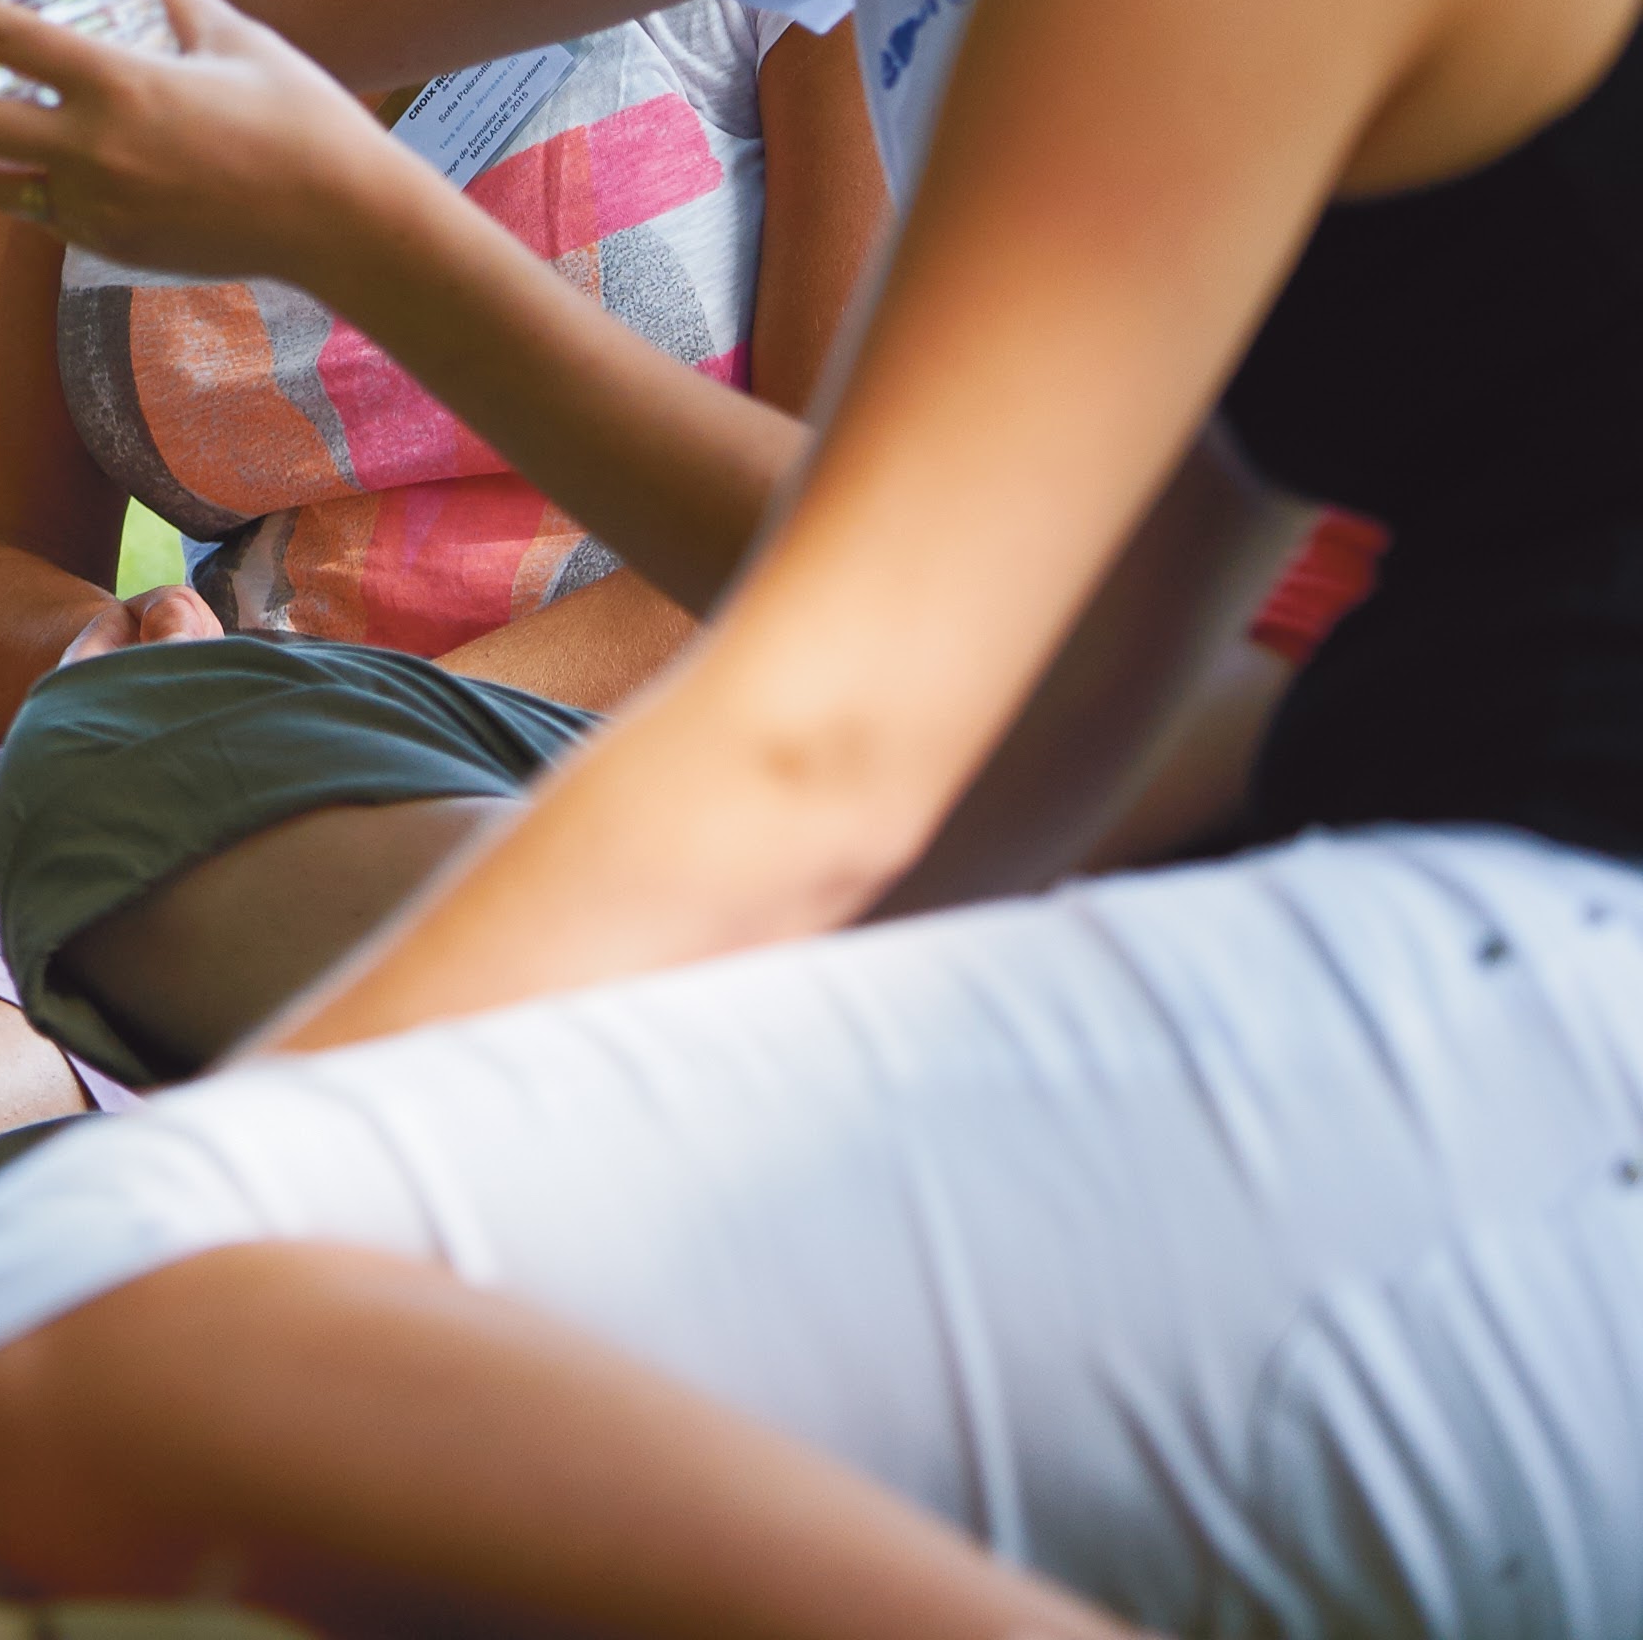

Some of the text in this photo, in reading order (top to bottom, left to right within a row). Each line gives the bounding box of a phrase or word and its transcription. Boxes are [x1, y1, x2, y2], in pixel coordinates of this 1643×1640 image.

[408, 72, 450, 120] CROIX-RO
[438, 60, 493, 124] Sofia Polizzotto
[443, 54, 548, 179] tage de formation des volontaires
[469, 91, 529, 161] MARLAGNE 2015
